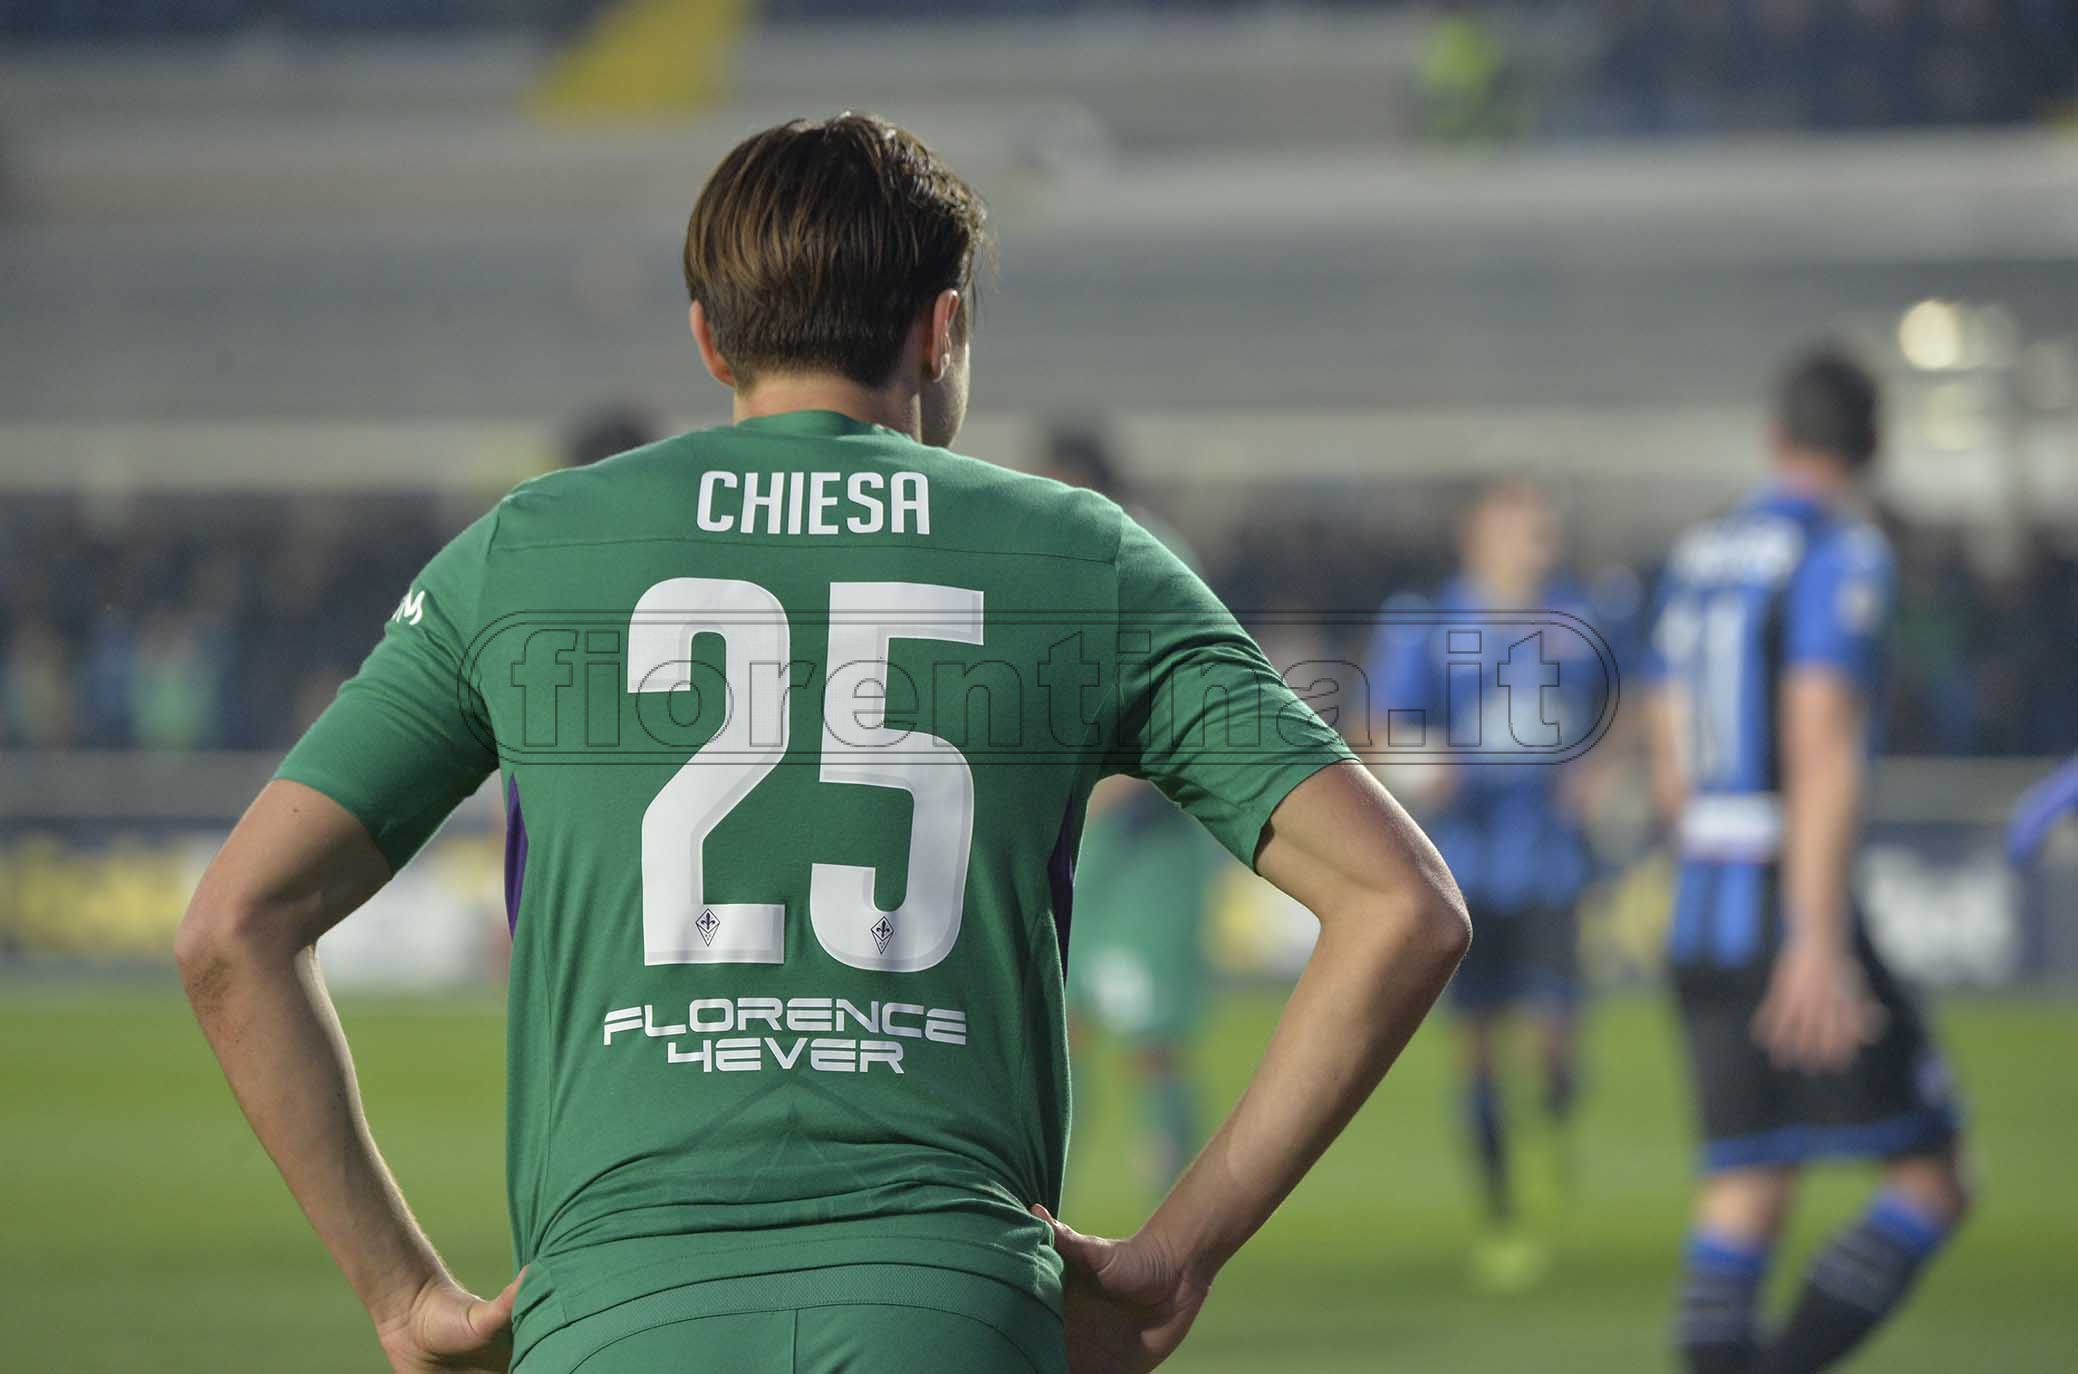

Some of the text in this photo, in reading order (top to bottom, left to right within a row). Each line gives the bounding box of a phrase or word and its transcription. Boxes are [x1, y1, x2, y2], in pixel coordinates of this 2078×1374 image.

[696, 469, 931, 536] CHIESA
[626, 576, 985, 973] 25
[602, 996, 967, 1046] FLORENCE
[667, 1036, 905, 1074] 4EVER
